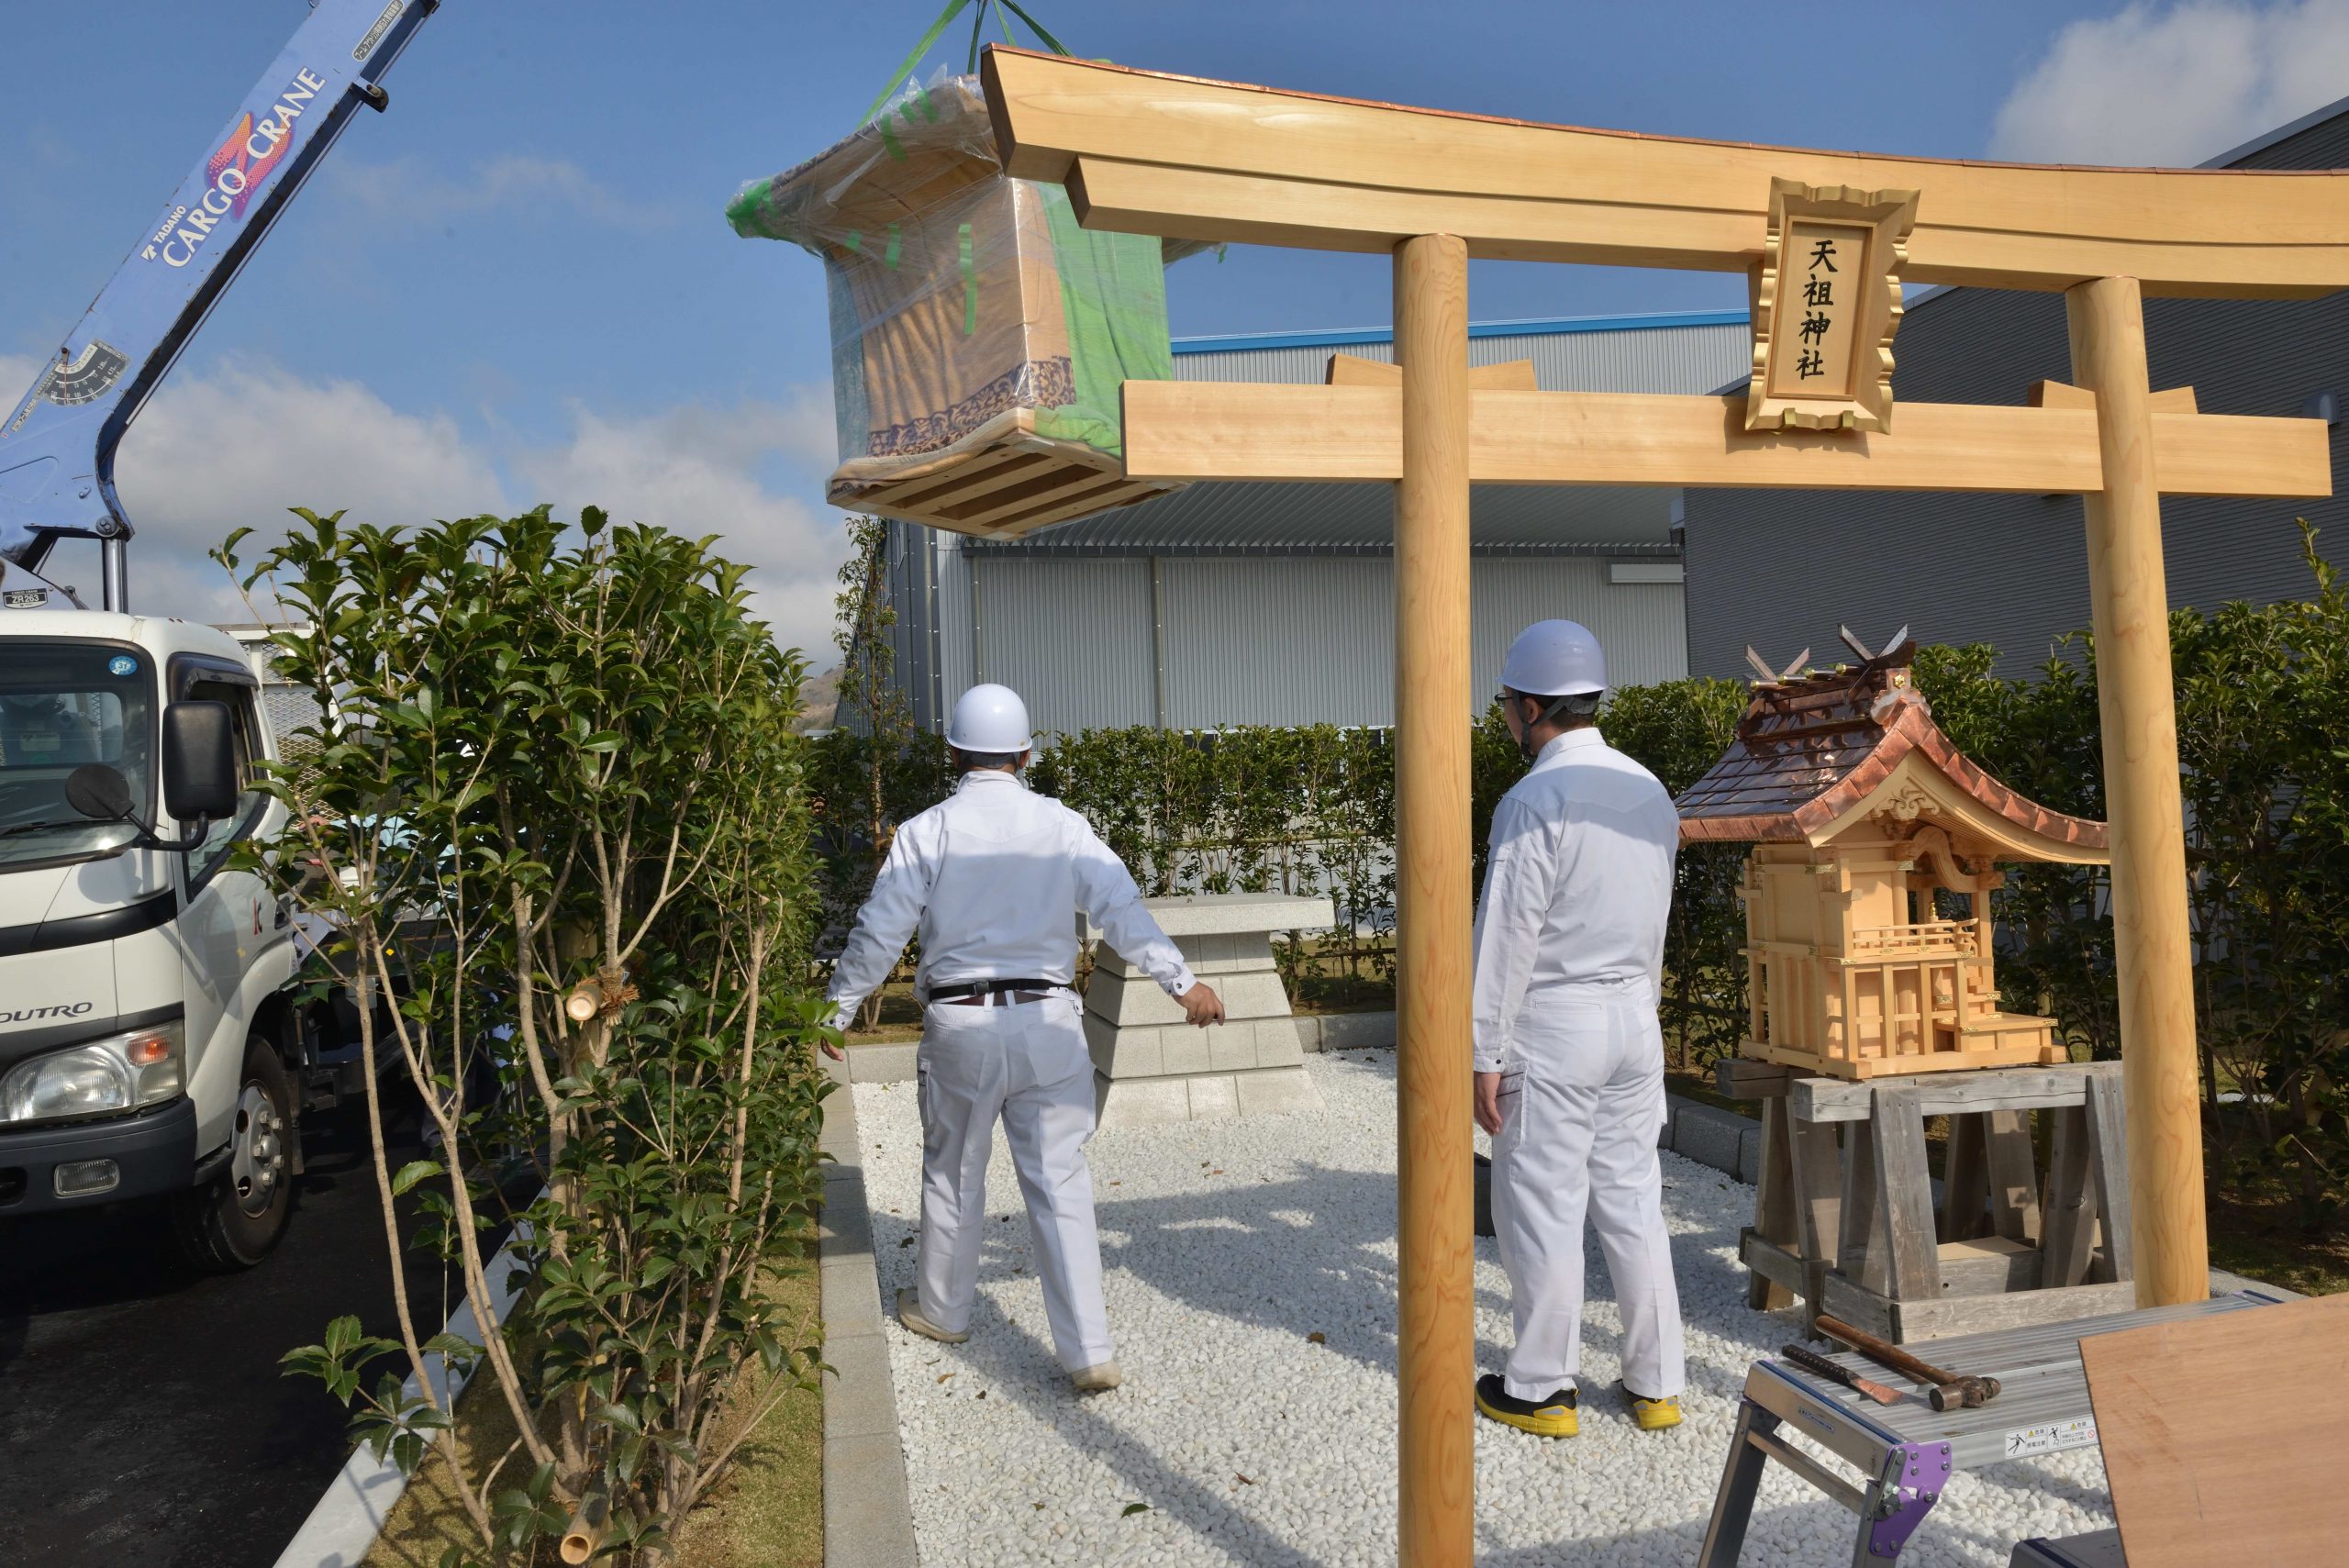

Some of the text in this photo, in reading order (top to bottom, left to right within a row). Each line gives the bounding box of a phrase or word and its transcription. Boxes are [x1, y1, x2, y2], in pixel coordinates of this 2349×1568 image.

[162, 66, 327, 267] CARGO CRANE
[152, 205, 186, 244] TADANO
[1795, 239, 1839, 380] 天祖神社
[12, 594, 39, 604] ZR263
